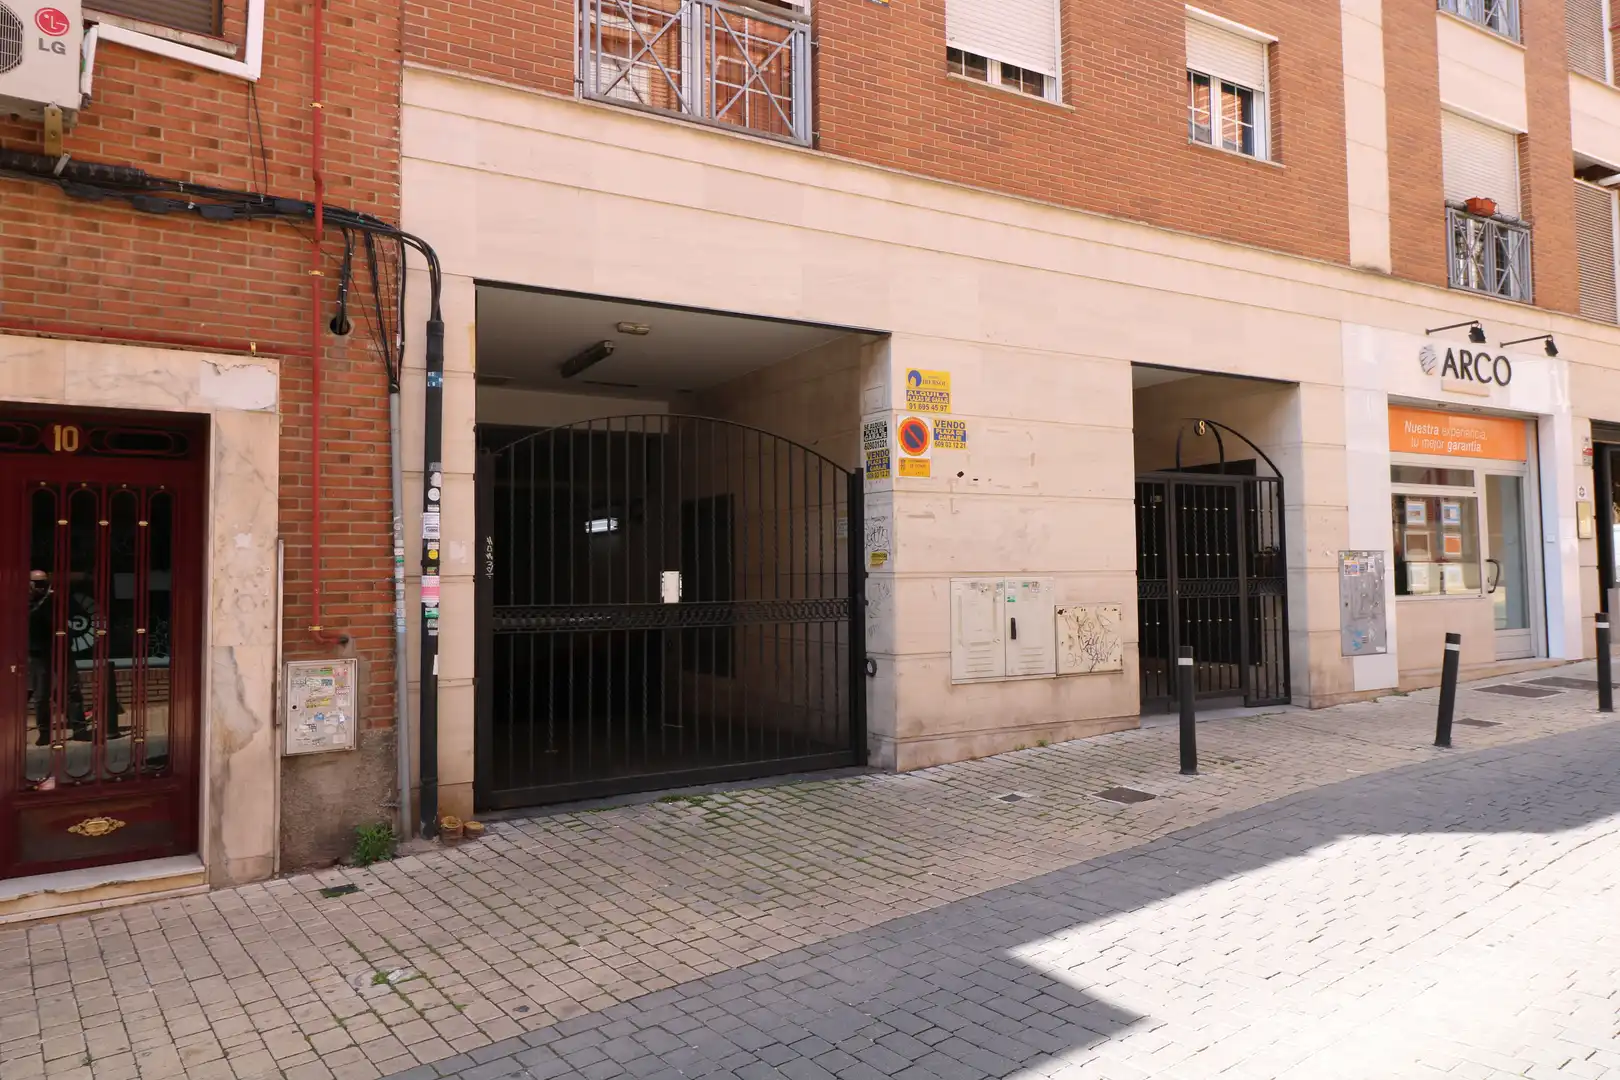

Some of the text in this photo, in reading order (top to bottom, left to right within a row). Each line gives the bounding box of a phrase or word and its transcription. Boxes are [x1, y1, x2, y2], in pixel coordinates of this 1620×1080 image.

[38, 37, 66, 55] LG
[1441, 347, 1512, 387] ARCO
[908, 390, 949, 398] ALQUILA
[870, 420, 887, 430] ALQUILA
[935, 420, 966, 429] VENDO
[1199, 420, 1206, 435] 8
[1405, 420, 1439, 435] Nuestra
[54, 425, 79, 452] 10
[1422, 438, 1444, 451] mejor
[867, 449, 890, 459] VENDO
